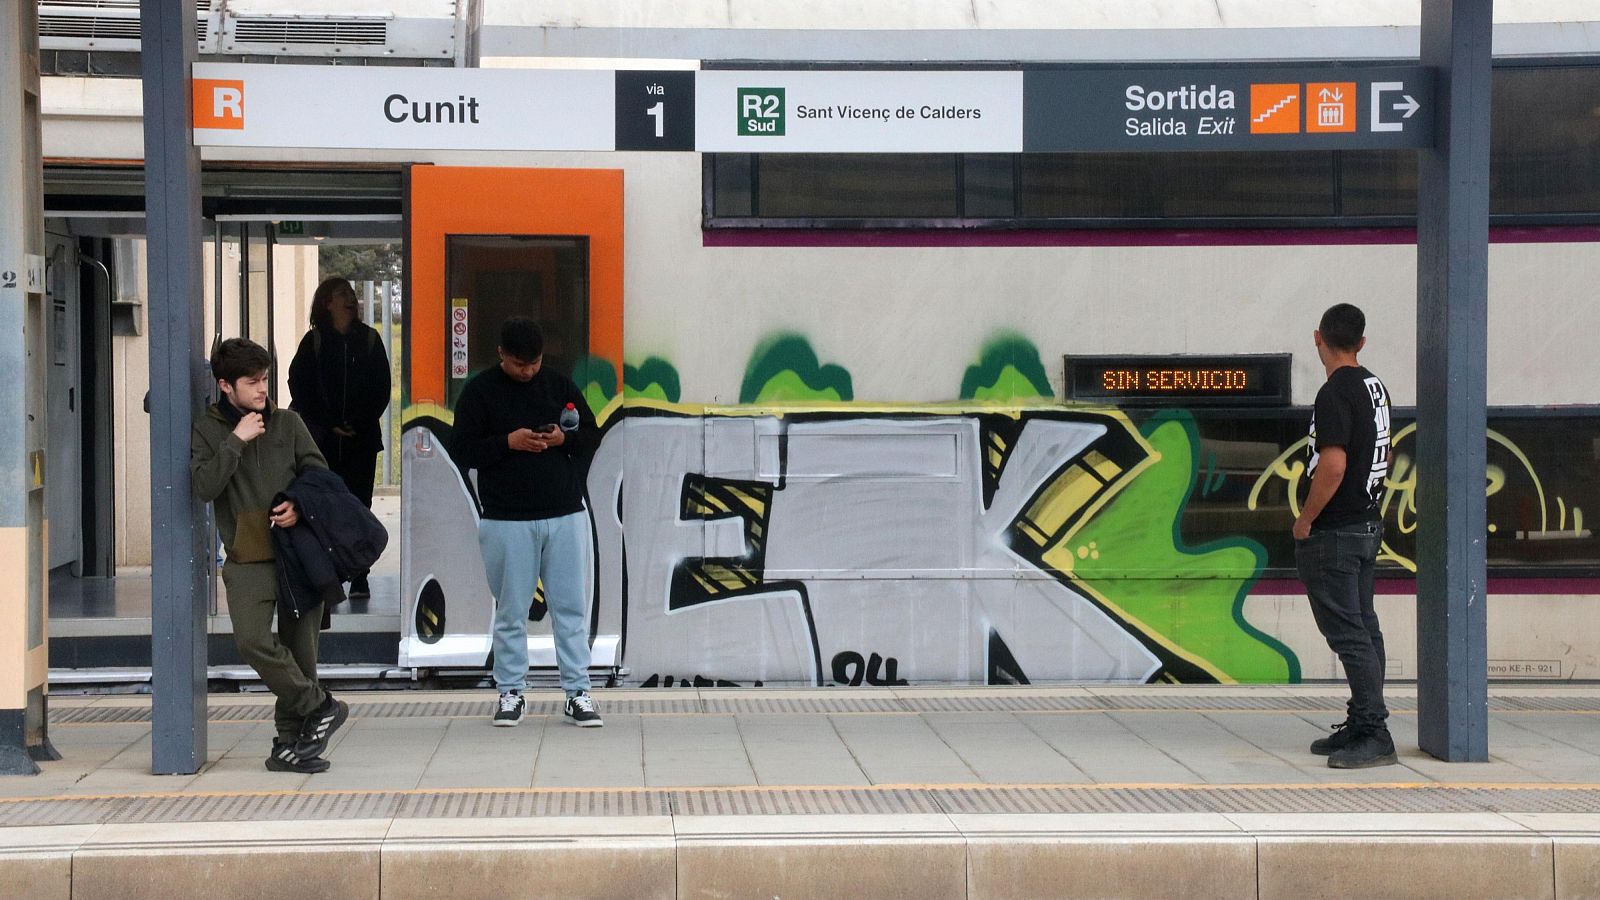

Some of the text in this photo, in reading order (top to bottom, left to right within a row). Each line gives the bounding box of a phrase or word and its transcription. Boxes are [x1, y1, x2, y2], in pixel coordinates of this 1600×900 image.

[647, 82, 665, 94] via
[1125, 84, 1236, 111] Sortida
[213, 87, 242, 118] R
[383, 93, 480, 124] Cunit
[742, 94, 780, 118] R2
[646, 101, 664, 138] 1
[796, 105, 982, 122] Sant Vicenç de Calders
[747, 119, 776, 132] Sud
[1125, 116, 1236, 136] Salida Exit
[1103, 370, 1246, 390] SIN SERVICIO
[1488, 665, 1507, 673] reno
